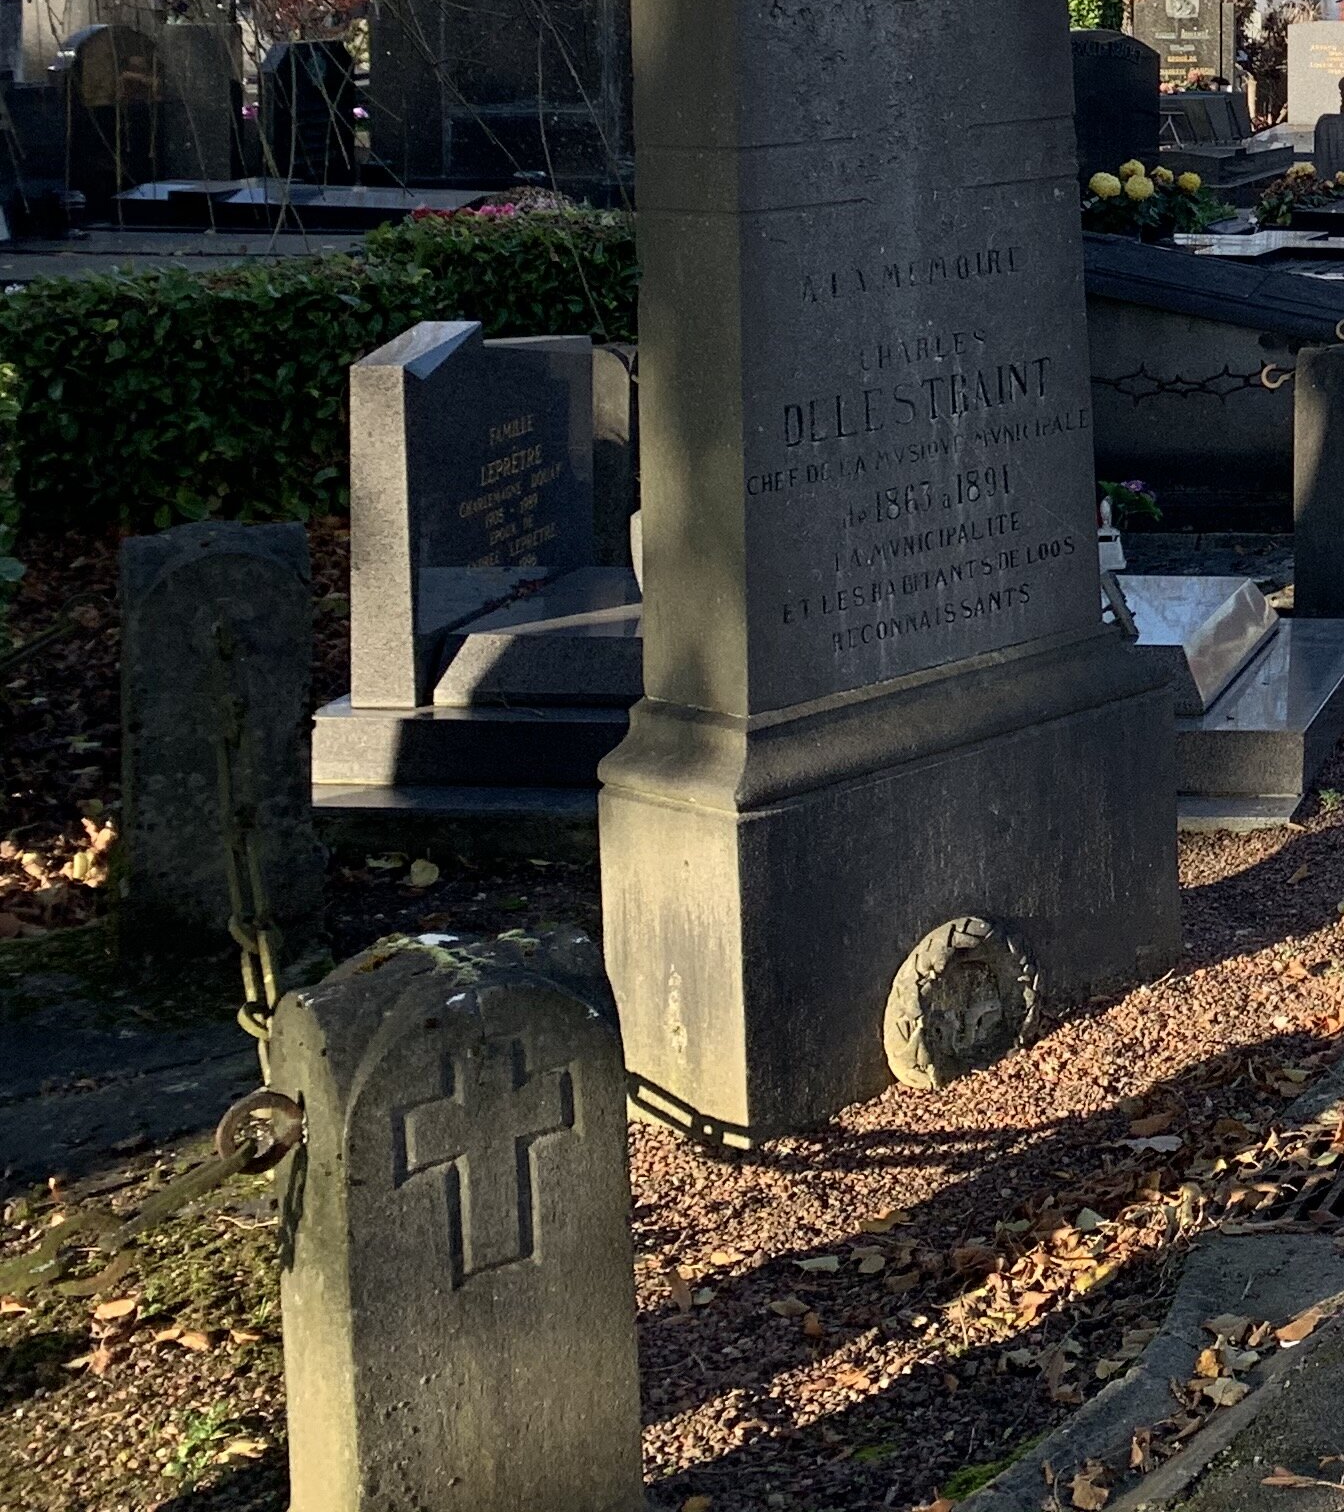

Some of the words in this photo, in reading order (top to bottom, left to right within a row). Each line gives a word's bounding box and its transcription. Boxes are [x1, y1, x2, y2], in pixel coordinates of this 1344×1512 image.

[803, 275, 818, 302] A
[831, 267, 867, 298] LA
[860, 329, 986, 371] CHARLES
[783, 357, 1050, 447] DELESTRAINT
[489, 414, 534, 445] FAMILLE
[747, 468, 799, 496] CHEF
[807, 462, 833, 484] DE
[840, 456, 866, 480] LA
[957, 464, 1010, 504] 1891
[783, 598, 810, 624] ET
[821, 586, 866, 614] LES
[870, 559, 993, 603] HABITANTS
[999, 549, 1020, 571] DE
[1027, 535, 1076, 564] LOOS
[834, 547, 862, 572] LA
[832, 583, 1031, 653] RECONNAISSANTS
